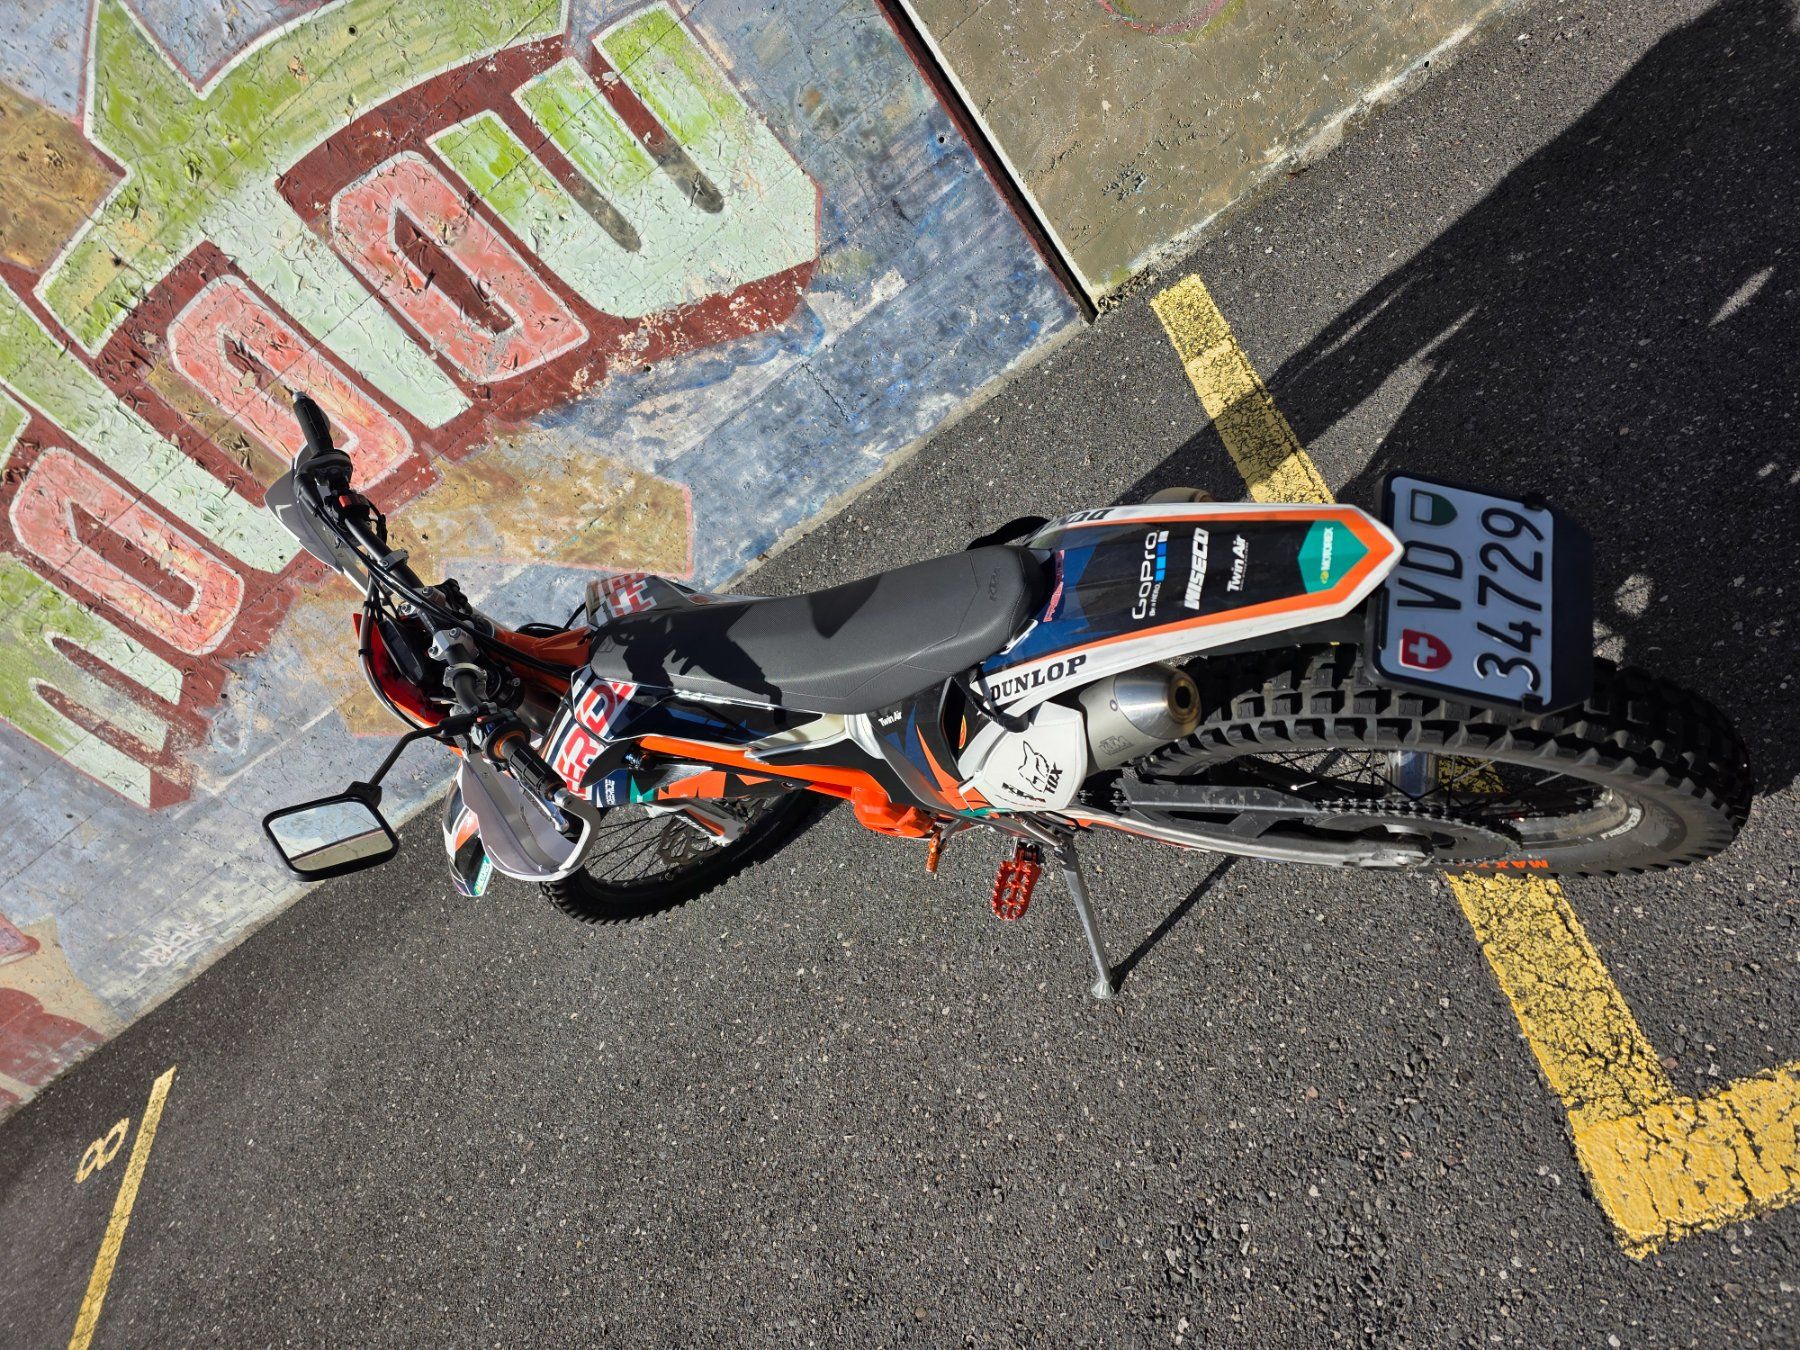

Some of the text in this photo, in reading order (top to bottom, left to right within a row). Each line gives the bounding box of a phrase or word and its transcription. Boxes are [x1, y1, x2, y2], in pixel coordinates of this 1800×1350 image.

[1184, 528, 1209, 610] WISECO
[1232, 534, 1246, 559] Air
[1131, 531, 1158, 619] GoPro
[1226, 558, 1245, 592] Twin
[1397, 540, 1463, 610] VD
[1474, 507, 1544, 691] 34729
[990, 654, 1087, 701] DUNLOP
[878, 715, 893, 727] Twin
[1044, 761, 1064, 795] FOX
